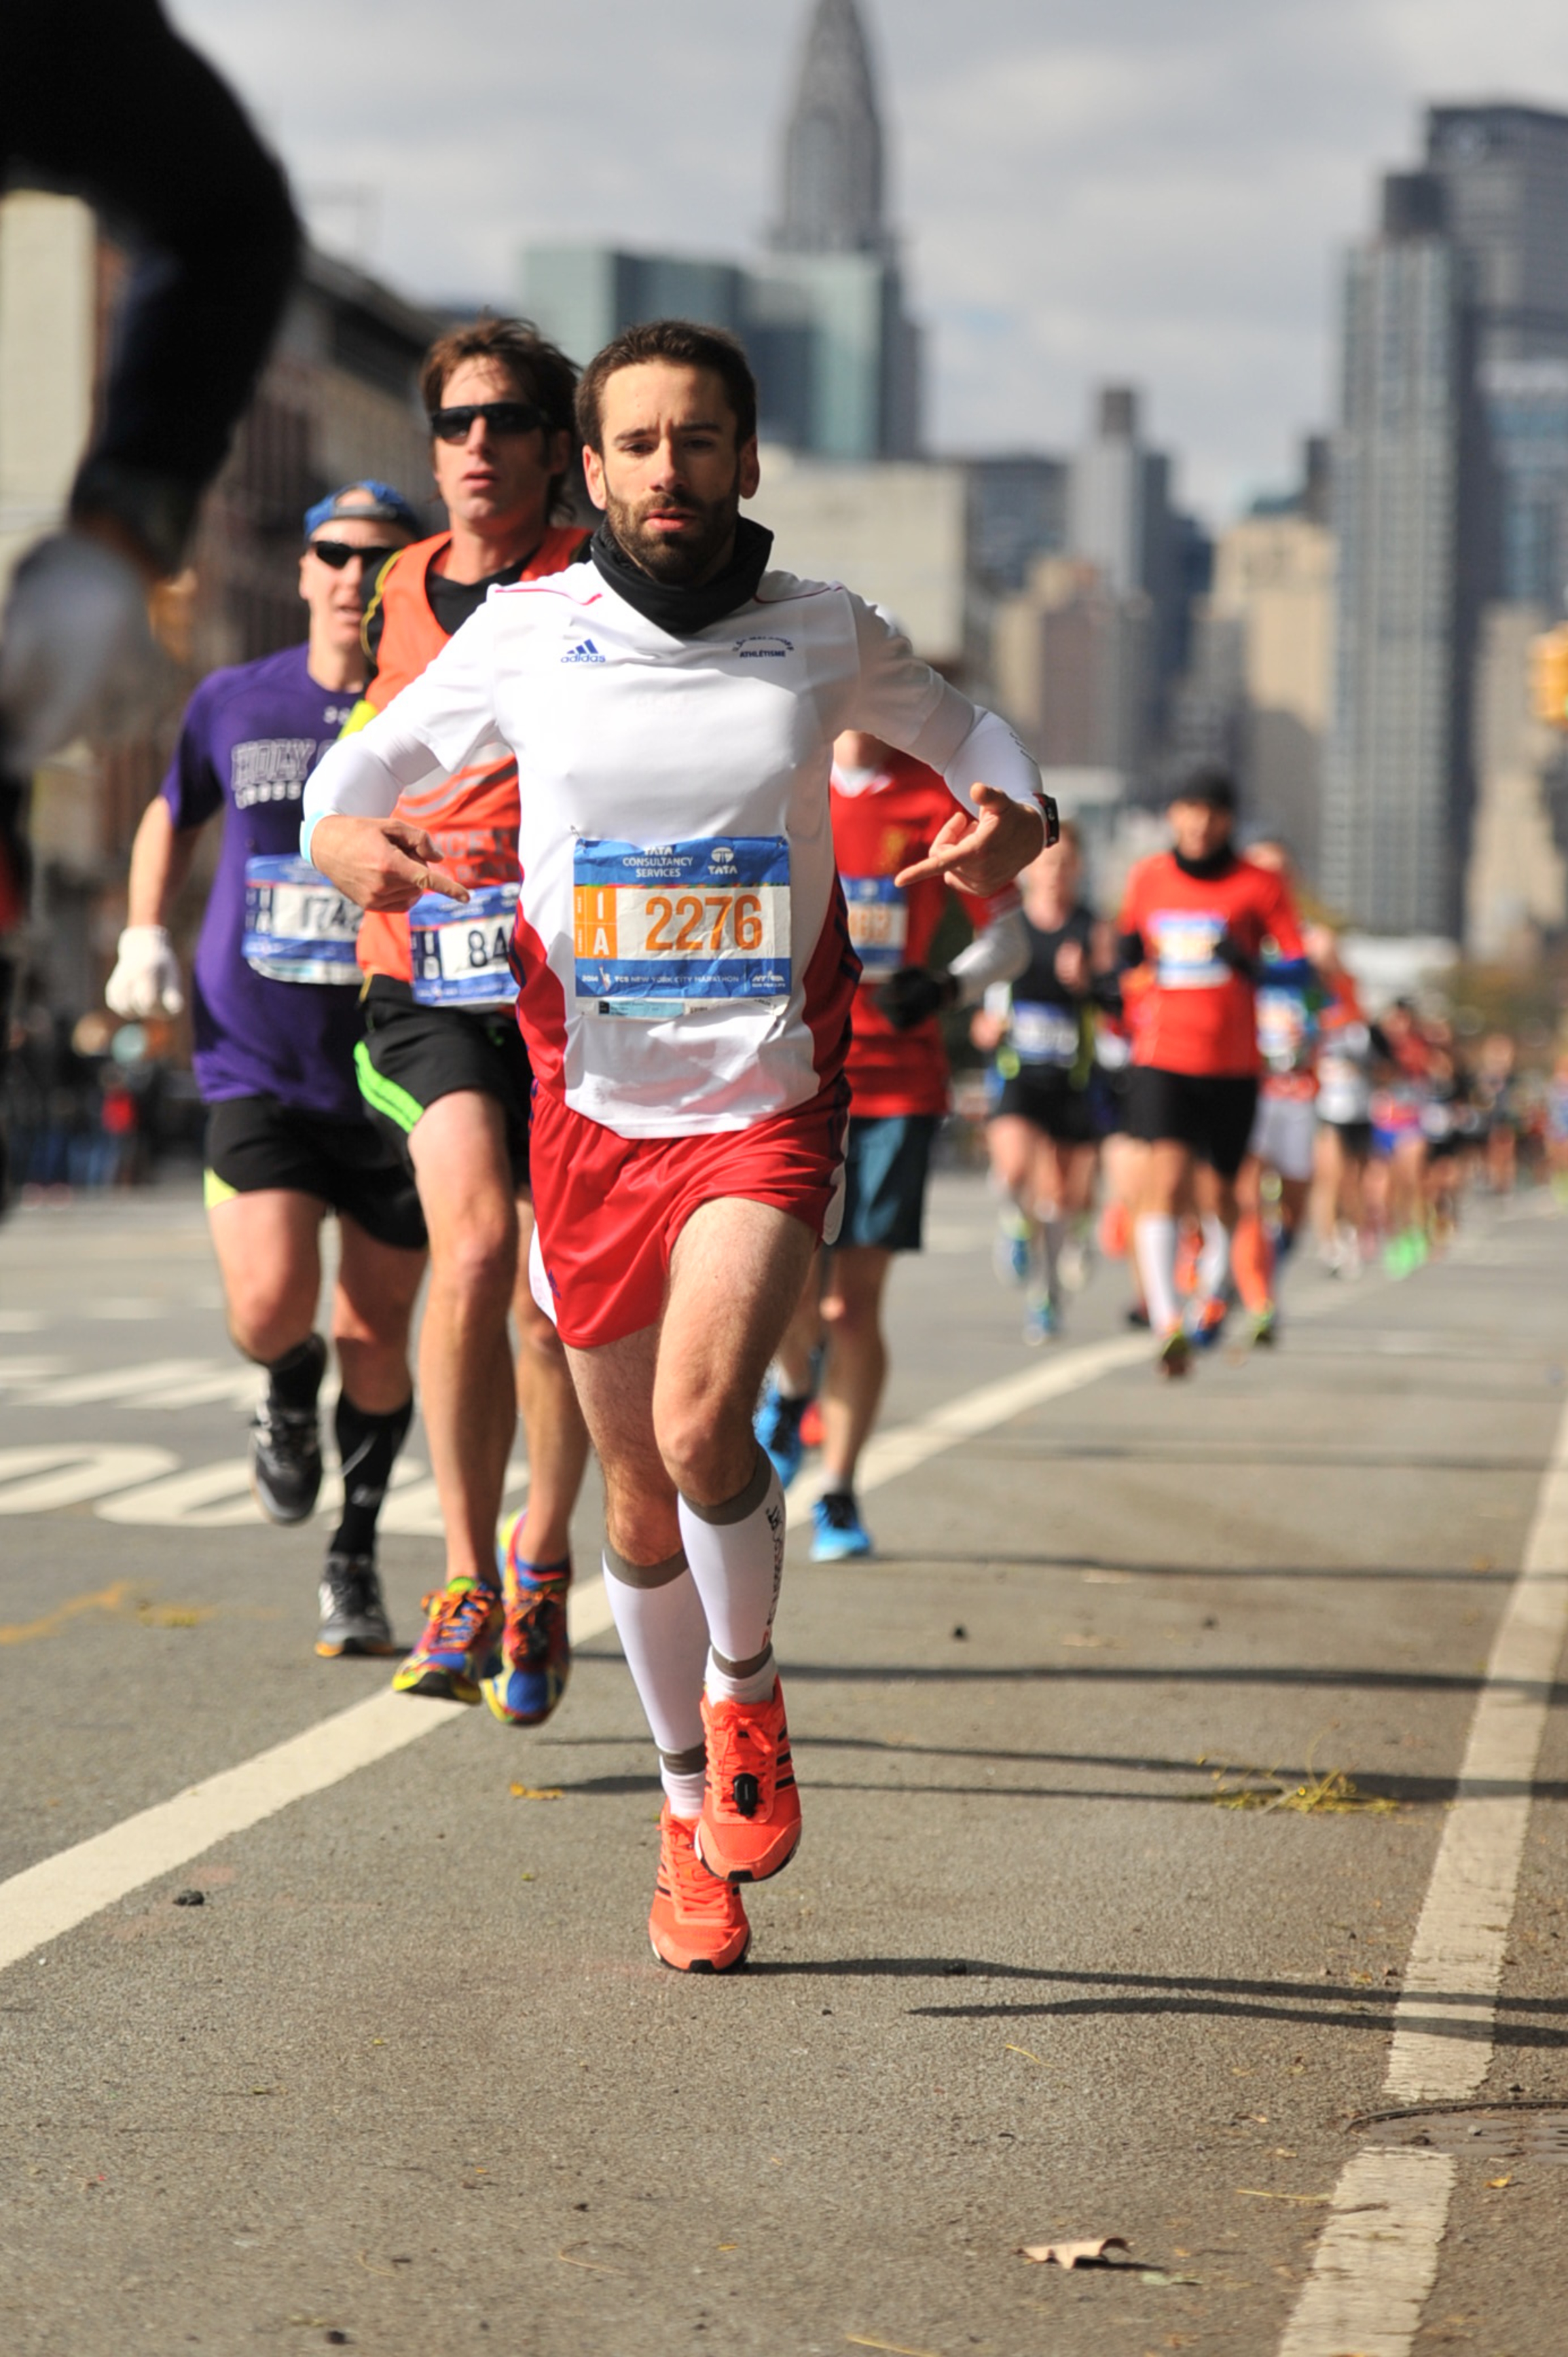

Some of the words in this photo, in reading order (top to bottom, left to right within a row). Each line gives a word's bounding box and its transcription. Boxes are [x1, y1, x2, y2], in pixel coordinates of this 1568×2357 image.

[560, 654, 606, 663] adidas
[740, 649, 786, 658] ATHLÉTISME
[644, 847, 673, 856] TATA
[623, 856, 693, 867] CONSULTANCY
[636, 868, 681, 878] SERVICES
[708, 865, 738, 875] TATA
[645, 894, 762, 951] 2276
[593, 928, 610, 955] A
